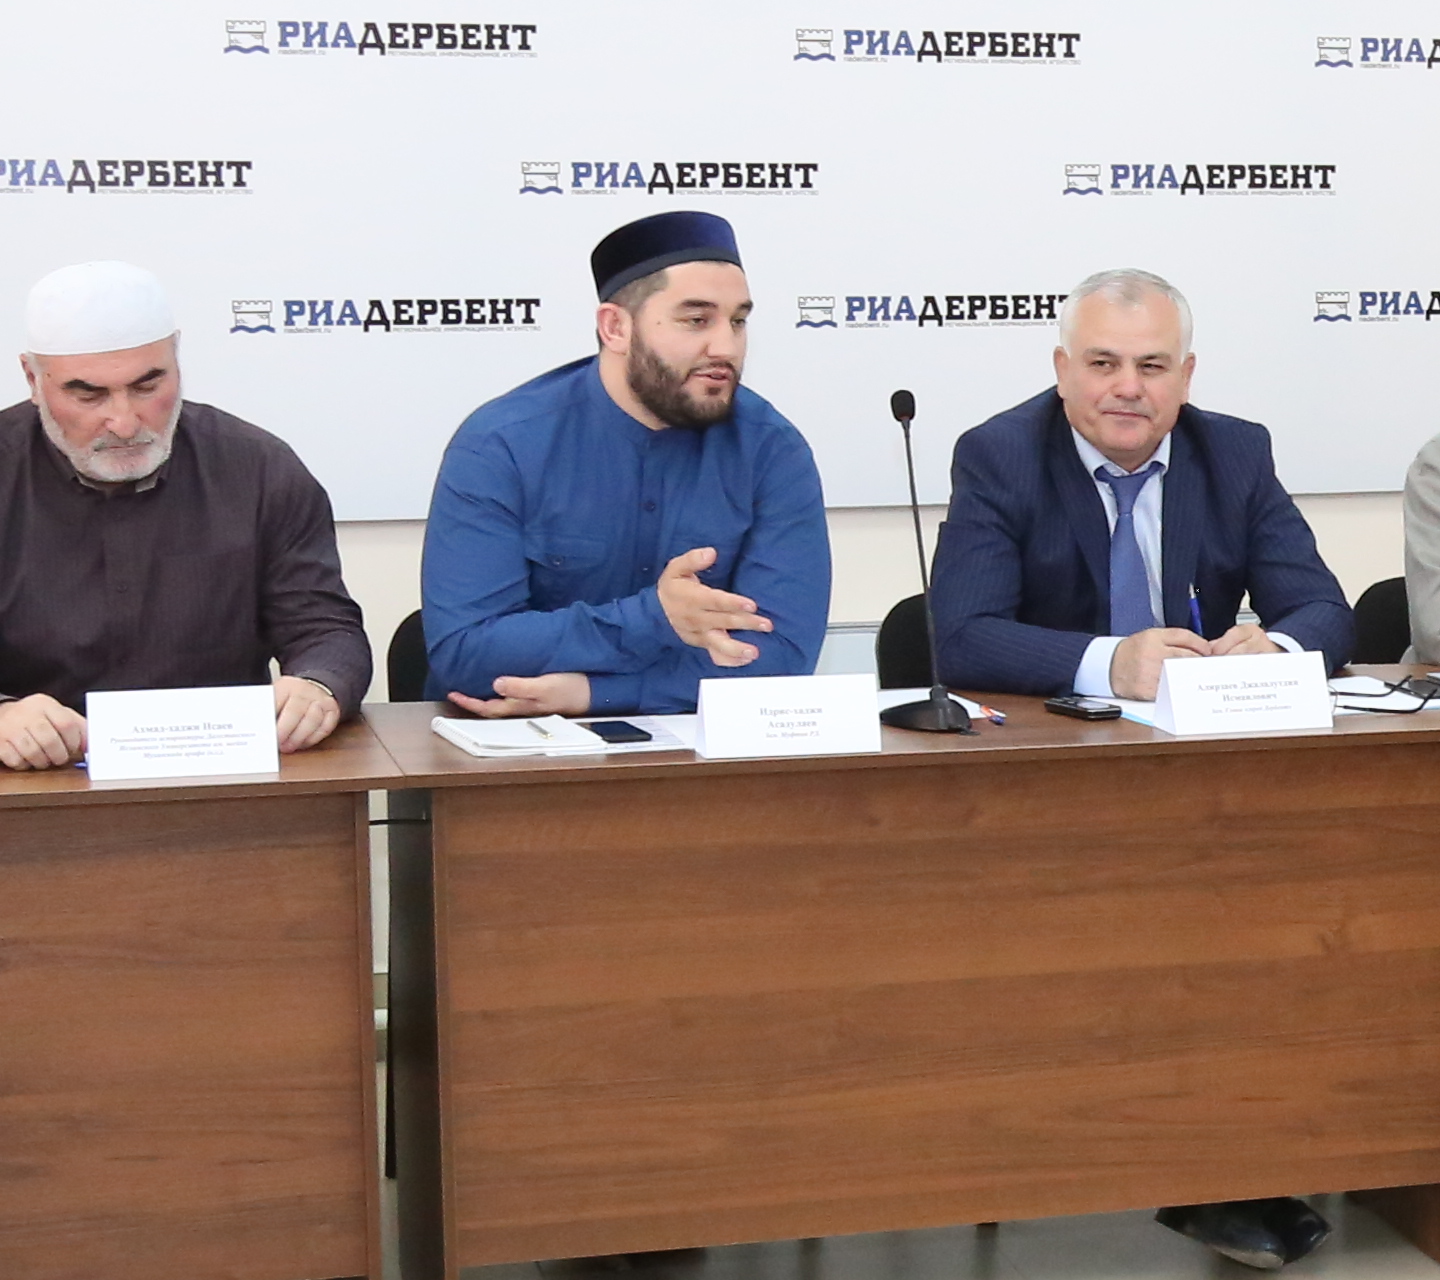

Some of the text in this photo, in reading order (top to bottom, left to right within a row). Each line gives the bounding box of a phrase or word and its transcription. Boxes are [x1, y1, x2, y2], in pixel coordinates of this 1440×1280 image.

[277, 20, 537, 56] РИАДЕРБЕНТ
[843, 29, 1081, 64] РИАДЕРБЕНТ
[571, 161, 819, 195] РИАДЕРБЕНТ
[1110, 163, 1337, 196] РИАДЕРБЕНТ
[283, 298, 541, 333] РИАДЕРБЕНТ
